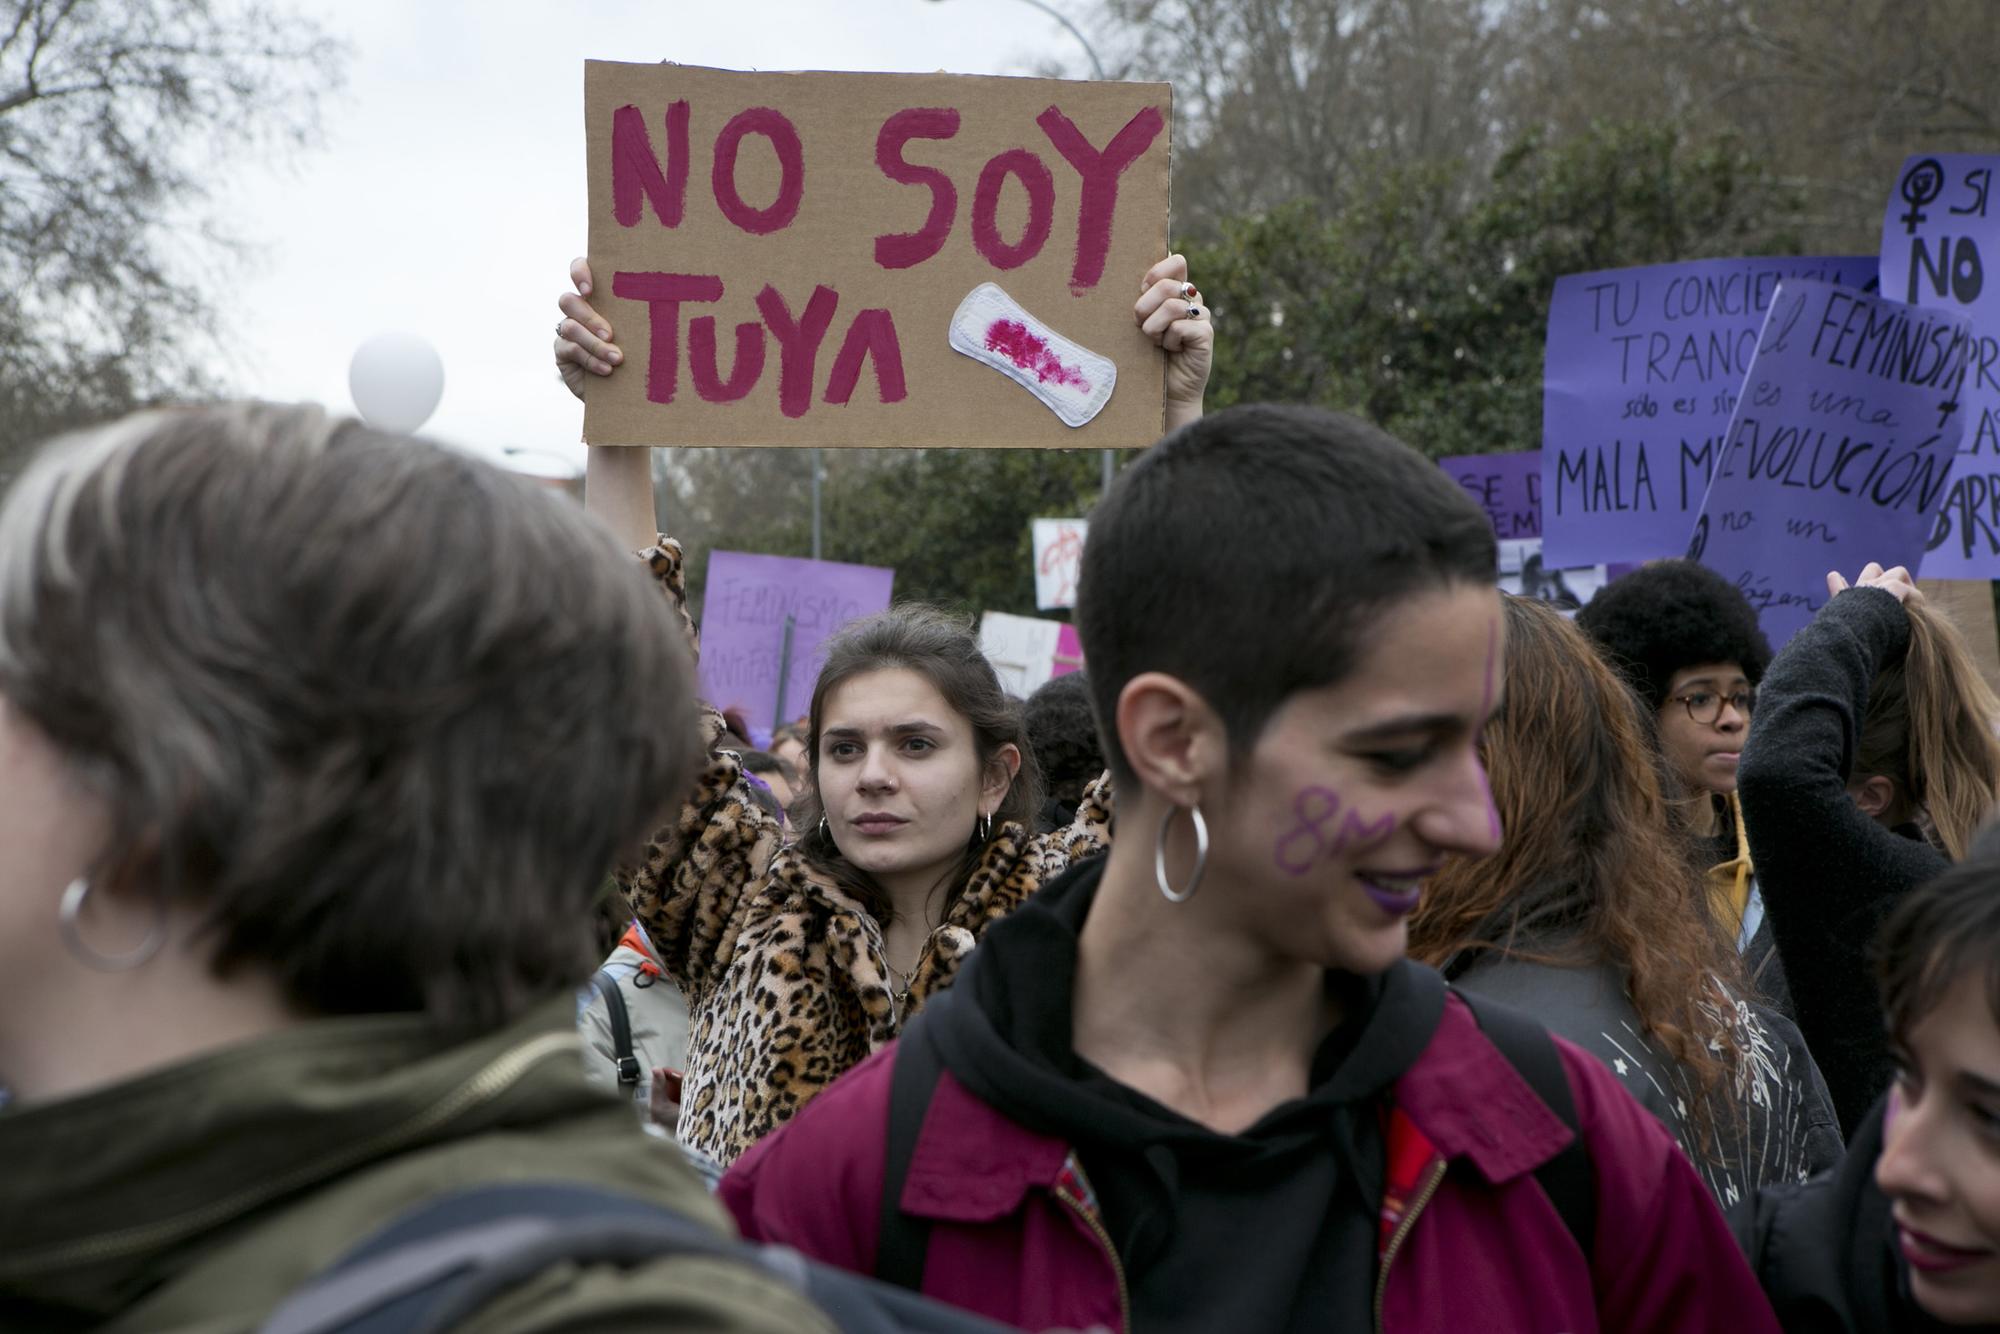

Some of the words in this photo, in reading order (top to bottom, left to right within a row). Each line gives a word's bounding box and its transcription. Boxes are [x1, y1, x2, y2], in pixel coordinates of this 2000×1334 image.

[611, 100, 804, 235] NO
[874, 105, 1165, 297] SOY
[1907, 236, 1984, 305] NO
[1586, 281, 1640, 333] TU
[612, 272, 908, 419] TUYA
[1673, 397, 1696, 415] es
[1753, 381, 1782, 406] es
[1809, 389, 1899, 428] una
[1556, 440, 1657, 516] MALA
[1720, 510, 1757, 533] no
[1785, 518, 1838, 543] un
[1275, 785, 1396, 876] 8M
